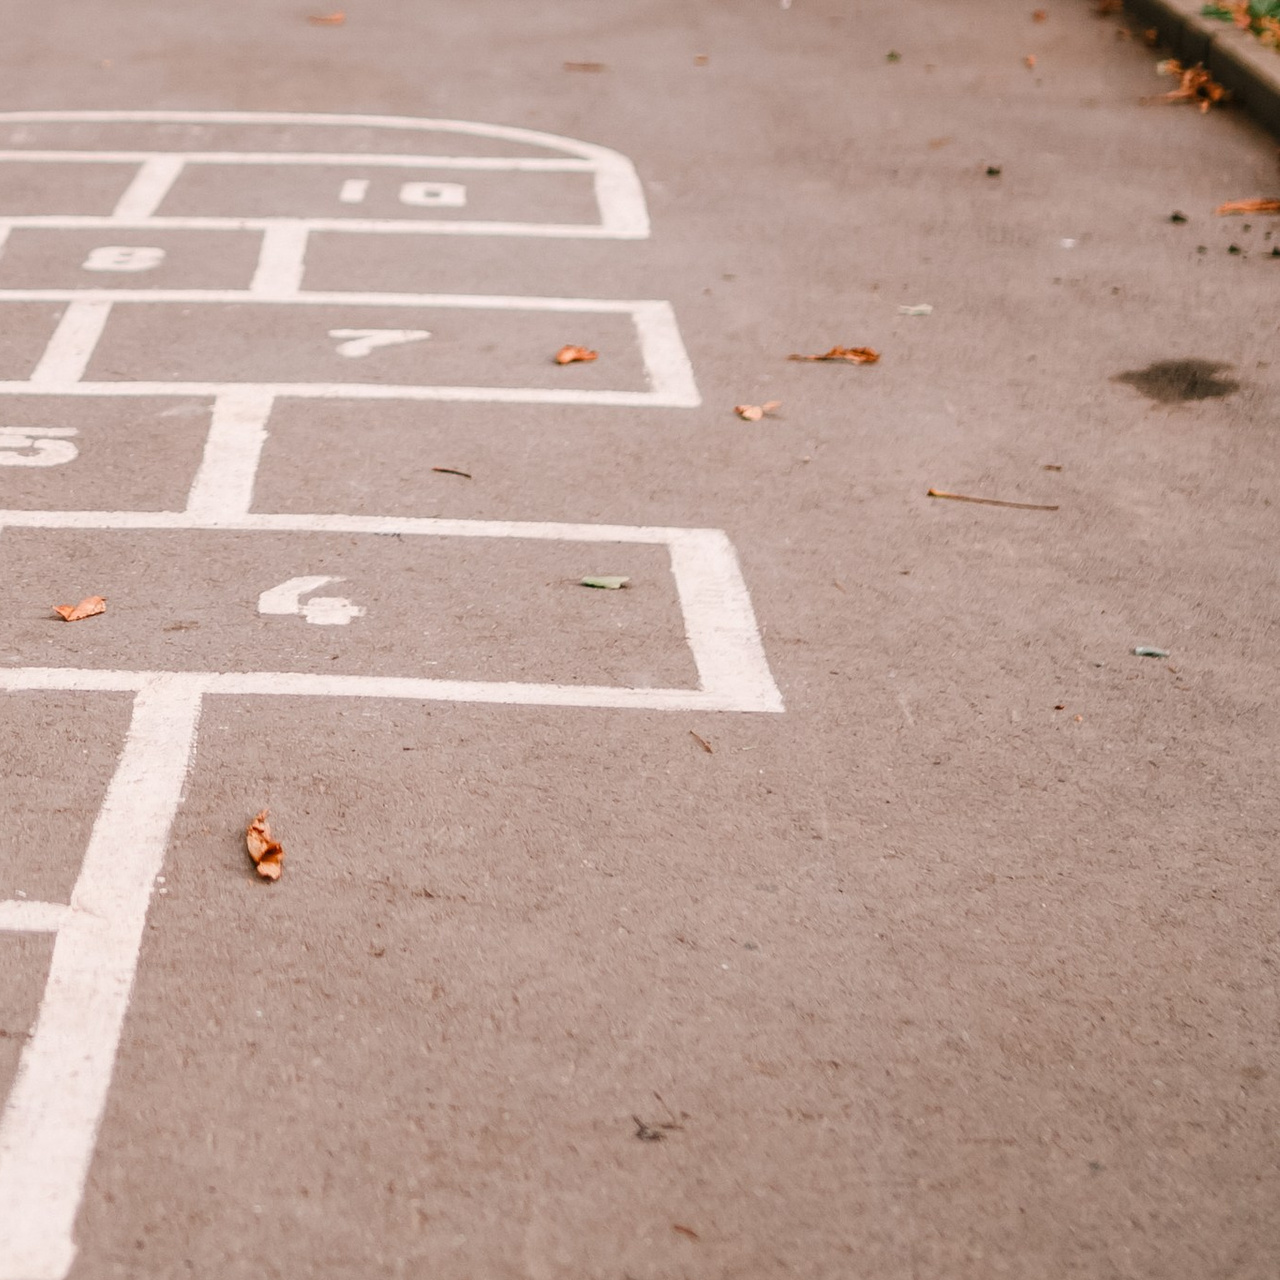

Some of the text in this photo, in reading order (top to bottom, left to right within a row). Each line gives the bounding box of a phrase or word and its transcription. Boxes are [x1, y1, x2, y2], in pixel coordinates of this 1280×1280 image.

[338, 178, 468, 208] 10
[81, 245, 166, 273] 8
[328, 327, 431, 359] 7
[257, 575, 366, 627] 4
